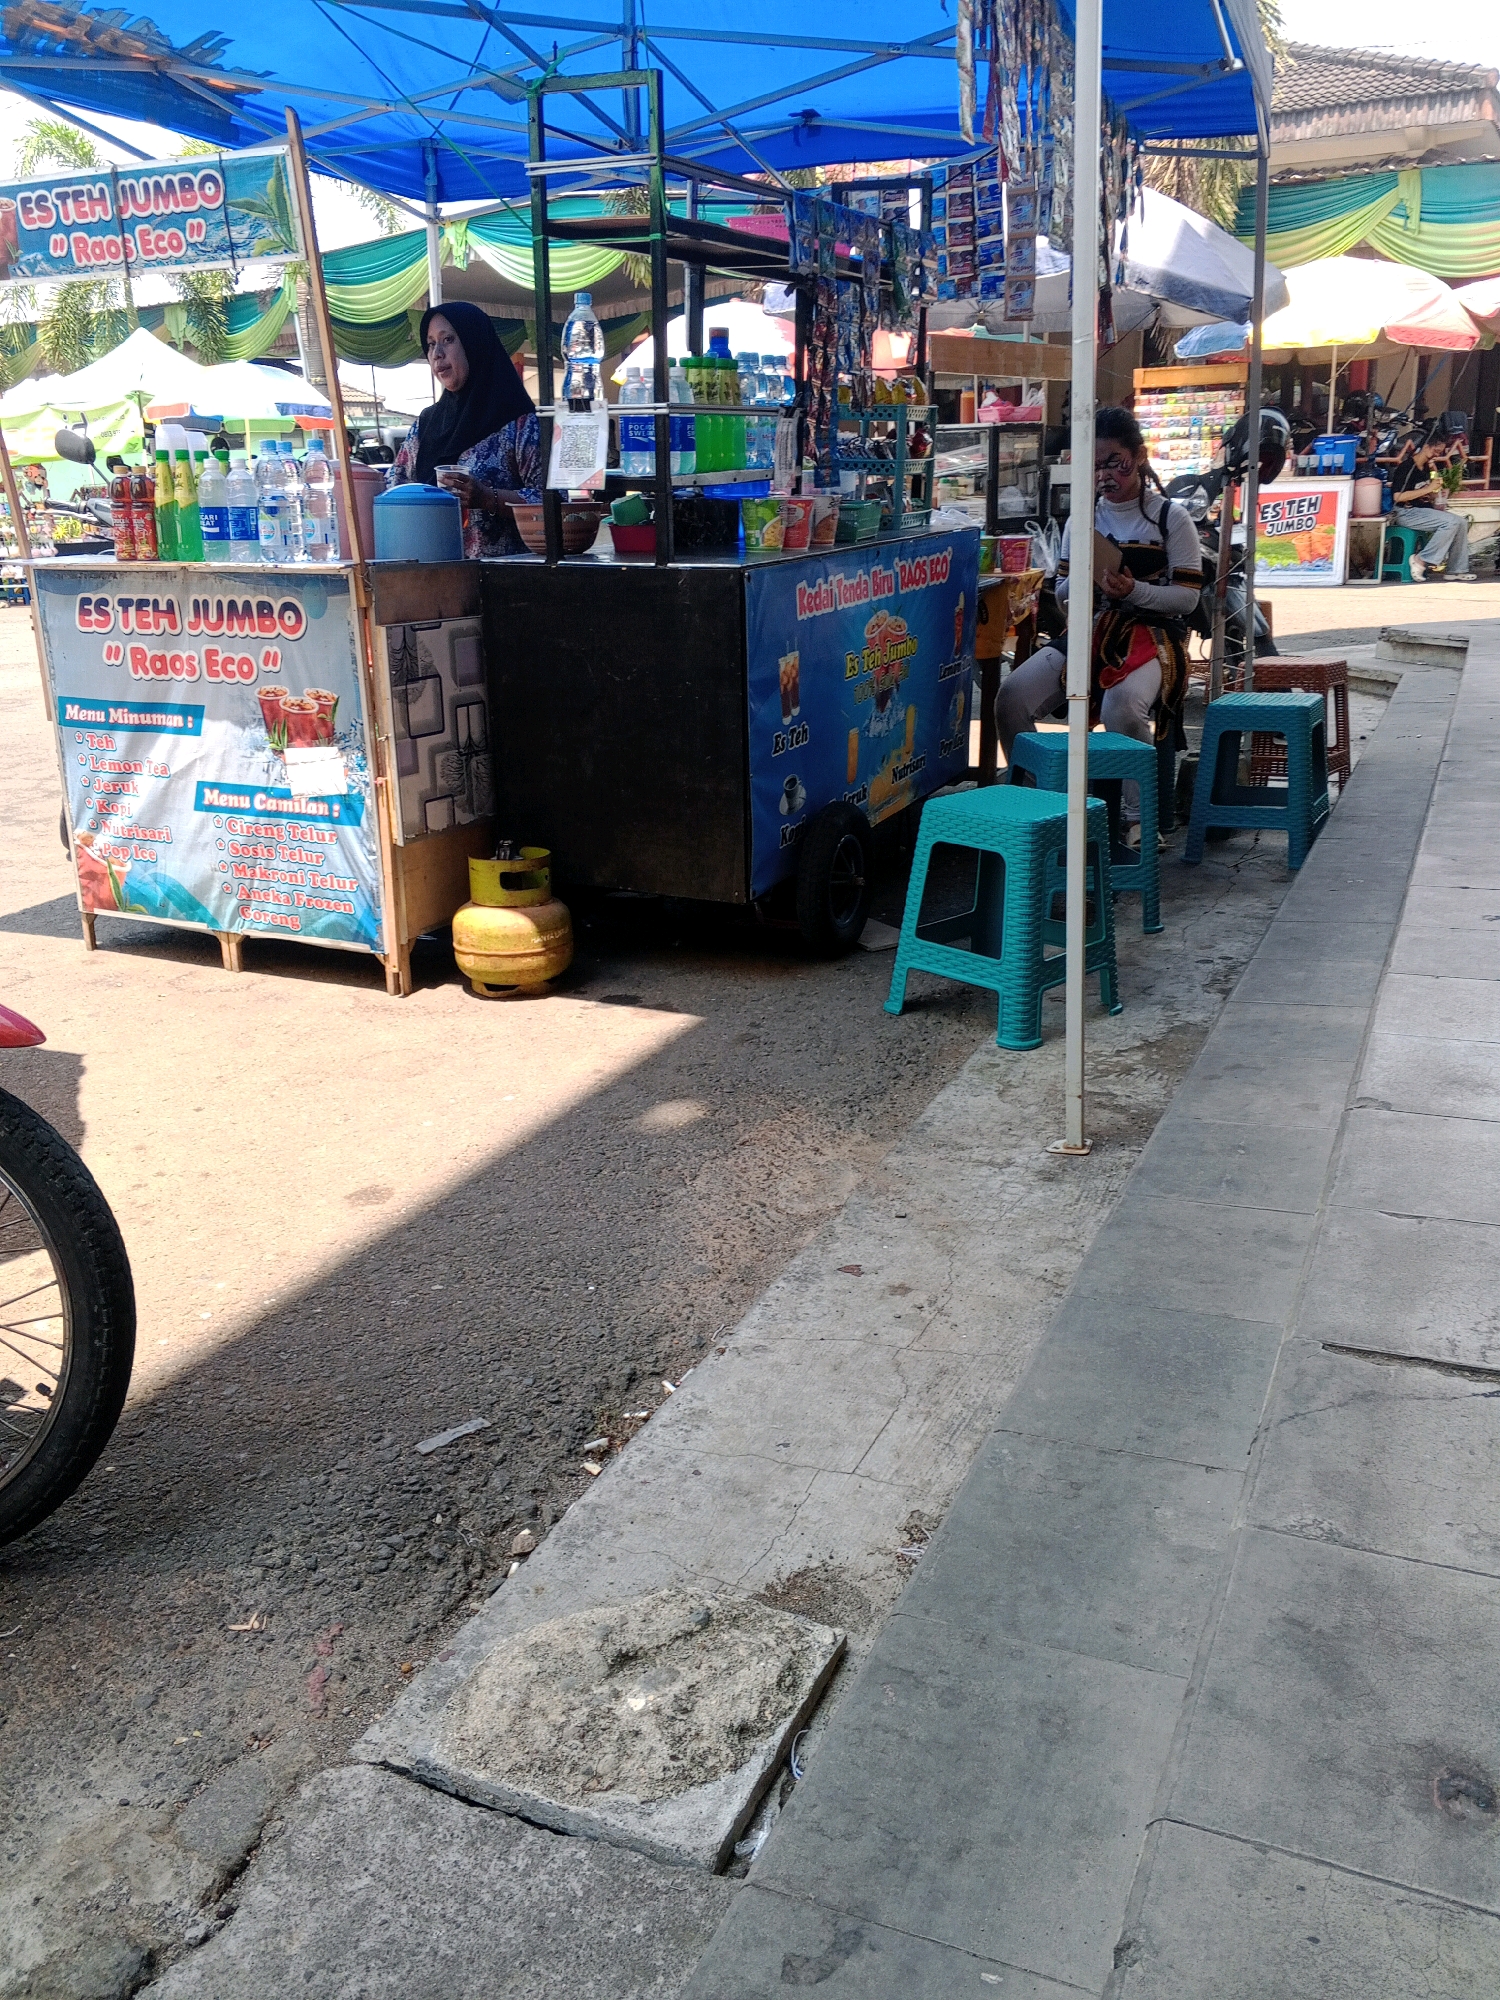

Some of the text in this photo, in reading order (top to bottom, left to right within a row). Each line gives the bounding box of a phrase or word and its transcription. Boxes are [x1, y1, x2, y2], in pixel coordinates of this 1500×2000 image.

[19, 171, 223, 228] ES TEH JUMBO
[1260, 495, 1321, 521] ES TEH
[1266, 516, 1316, 535] JUMBO
[796, 580, 835, 619] Kedai
[836, 571, 870, 607] Tenda
[871, 567, 894, 599] Biru
[77, 596, 304, 638] ES TEH JUMBO
[844, 633, 919, 680] Es Teh Jumbo
[65, 704, 106, 722] Menu
[108, 708, 184, 729] Minuman
[86, 734, 116, 750] Teh
[771, 721, 810, 757] Es Teh
[89, 755, 170, 777] Lemon Tea
[891, 749, 928, 785] Nutrisari
[93, 778, 140, 795] Jeruk
[95, 799, 132, 819] Kopi
[203, 788, 250, 809] Menu
[254, 792, 330, 816] Camilan
[101, 820, 172, 843] Nutrisari
[226, 818, 338, 844] Cireng Telur
[102, 843, 157, 862] Pop Ice
[228, 841, 325, 865] Sosis Telur
[232, 863, 359, 891] Makroni Telur
[237, 884, 355, 914] Aneka Frozen
[239, 906, 301, 931] Goreng
